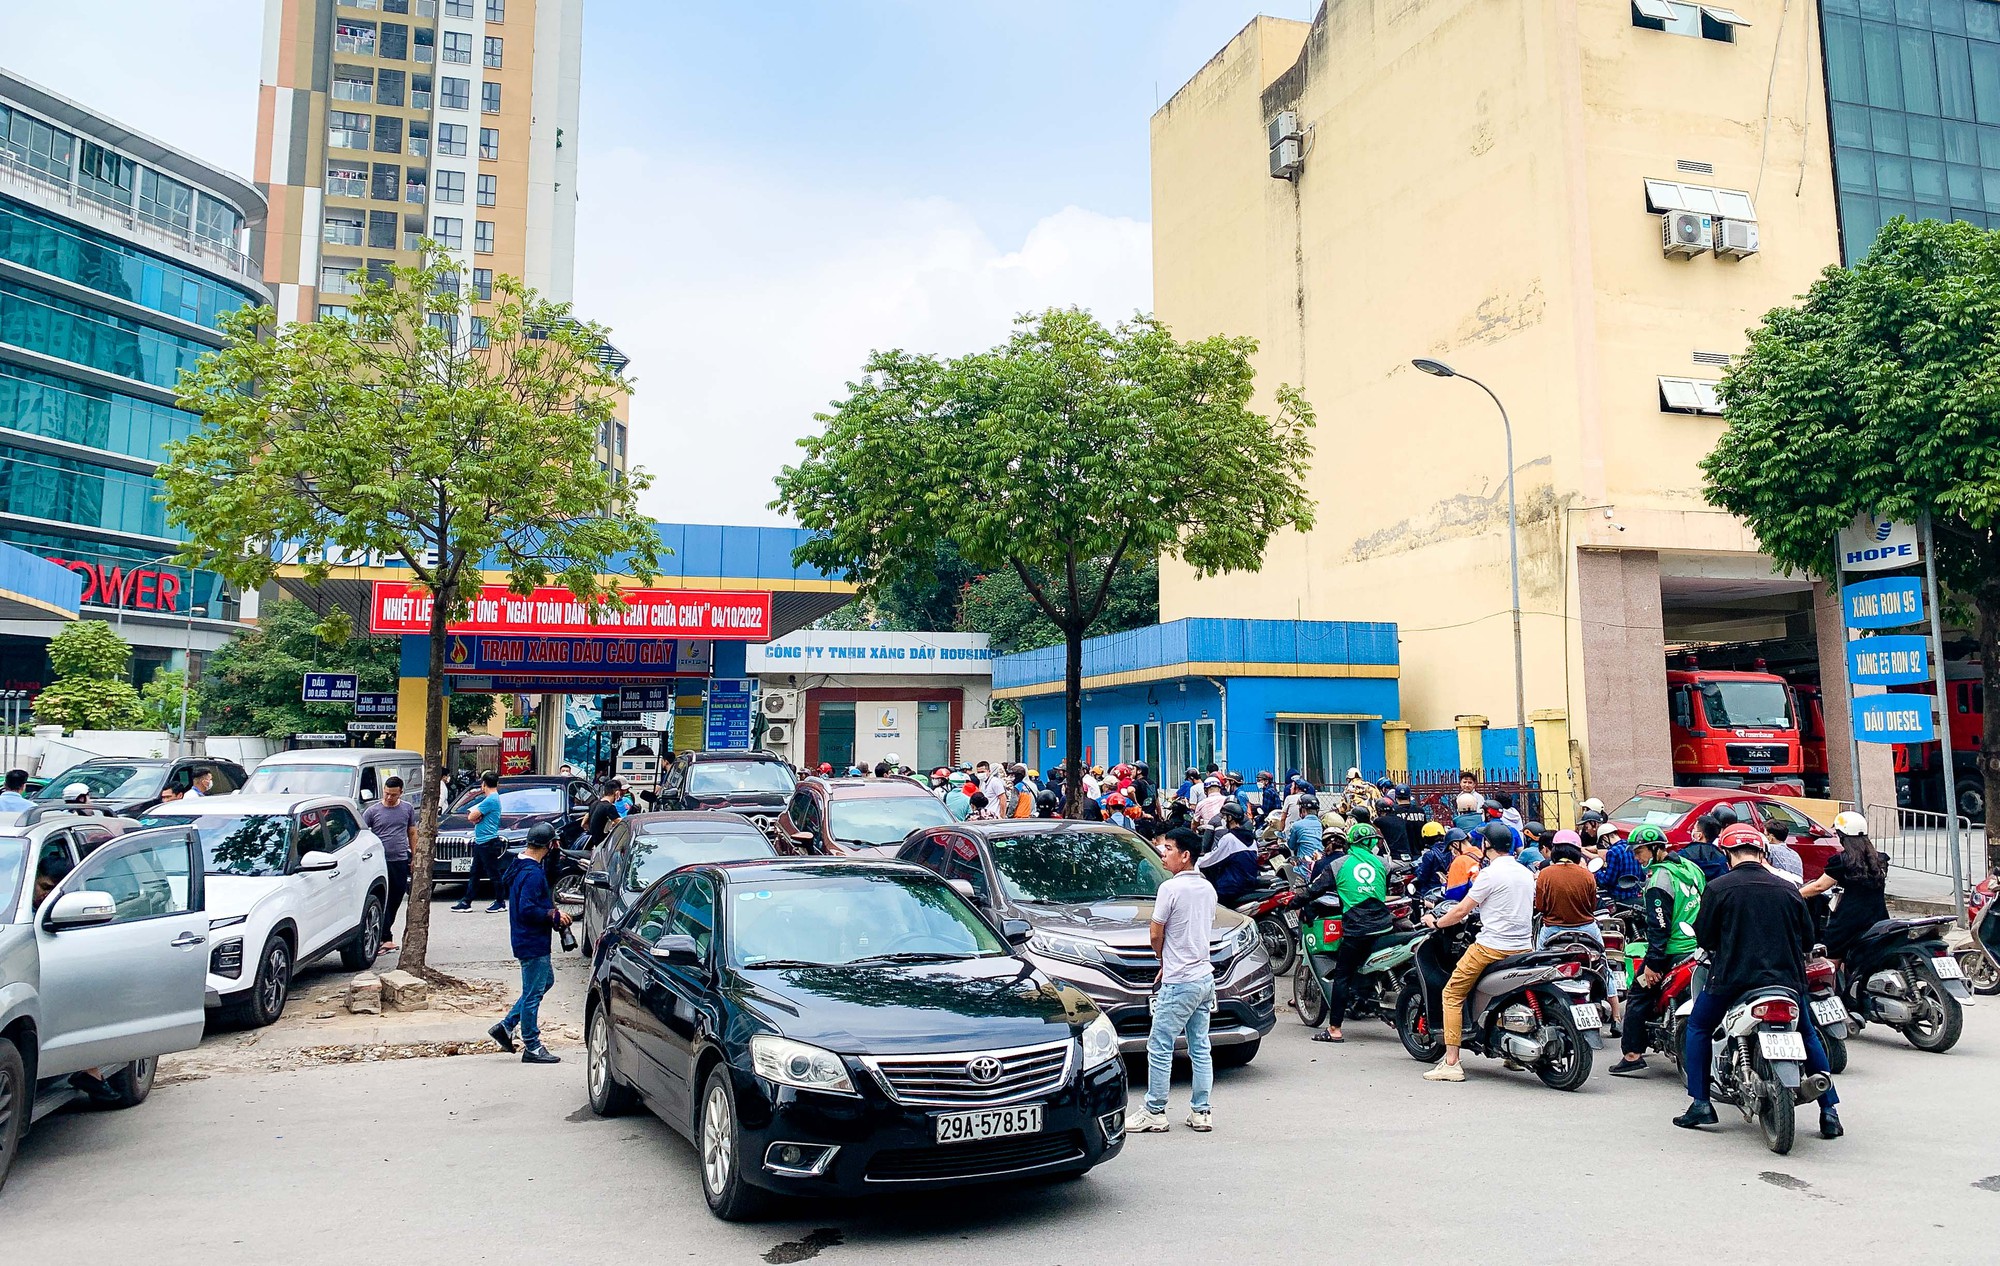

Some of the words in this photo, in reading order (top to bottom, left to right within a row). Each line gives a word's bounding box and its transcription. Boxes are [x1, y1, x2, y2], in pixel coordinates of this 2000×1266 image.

[1847, 543, 1912, 564] HOPE
[46, 556, 180, 612] OWER
[382, 594, 414, 626] NHIỆT
[415, 594, 435, 627] LIỆ
[477, 594, 498, 623] ỨNG
[536, 596, 562, 625] TOÀN
[564, 598, 585, 625] DÂN
[623, 600, 649, 626] CHÁY
[651, 600, 676, 627] CHỮA
[711, 606, 762, 628] 04/10/2022
[1852, 592, 1879, 618] XĂNG
[1881, 592, 1901, 616] RON
[1902, 590, 1916, 614] 95
[481, 640, 524, 666] TRẠM
[527, 637, 570, 663] XĂNG
[765, 644, 801, 659] CÔNG
[805, 646, 824, 658] TY
[828, 646, 866, 659] TNHH
[869, 645, 905, 659] XĂNG
[909, 644, 935, 659] DẦU
[1856, 649, 1879, 676] XĂNG
[1879, 653, 1890, 675] E5
[1891, 651, 1908, 674] RON
[1909, 650, 1921, 674] 92
[1863, 706, 1884, 732] DẦU
[1886, 709, 1922, 732] DIESEL
[503, 736, 519, 752] THAY
[1655, 907, 1666, 929] gojek
[1575, 1003, 1594, 1014] 15-K1
[1818, 1009, 1847, 1024] 721.51
[1765, 1046, 1803, 1058] 340.22
[940, 1108, 1037, 1141] 29A-578.51
